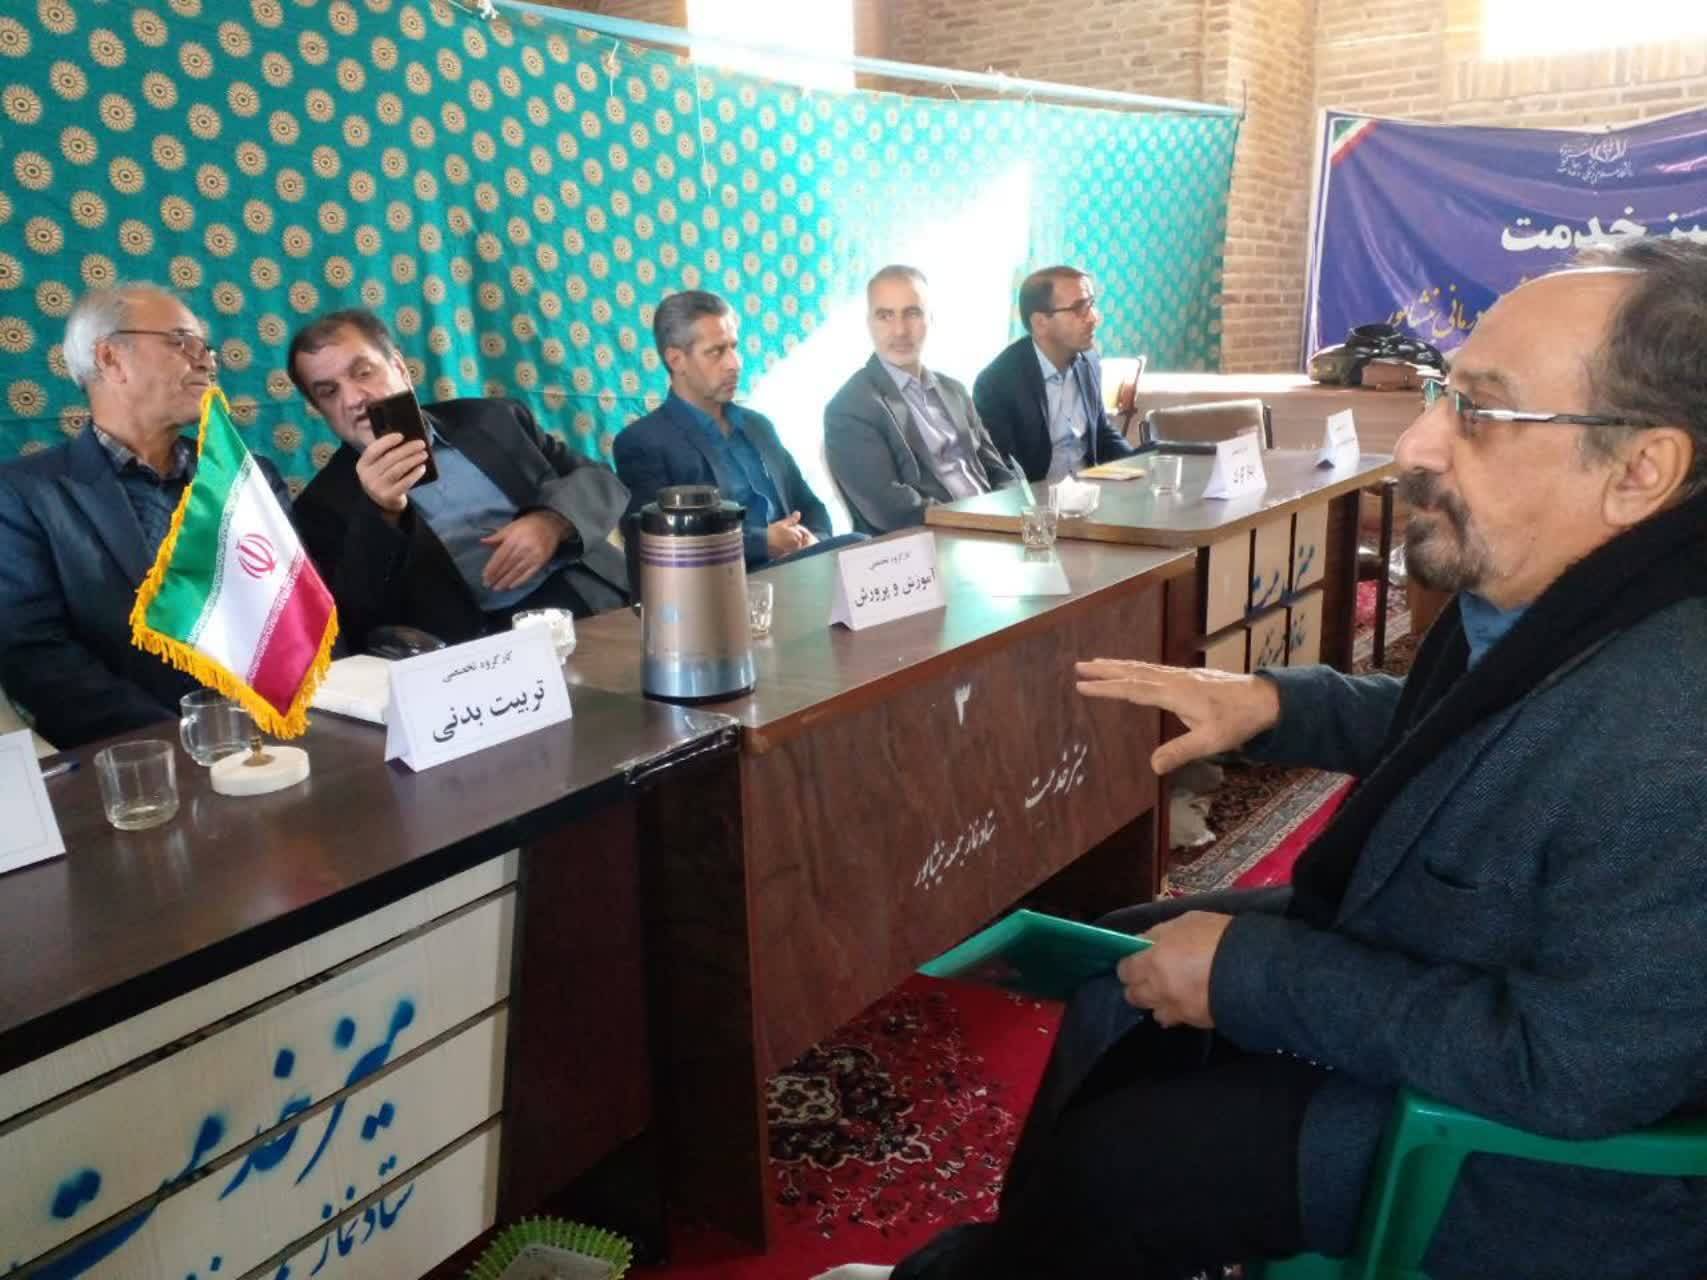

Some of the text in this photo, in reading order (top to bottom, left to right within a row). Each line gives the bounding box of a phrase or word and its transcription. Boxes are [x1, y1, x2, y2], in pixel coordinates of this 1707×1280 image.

[1501, 206, 1647, 252] خدمت
[854, 586, 890, 608] پرورش
[902, 566, 936, 595] آموزش
[432, 679, 546, 743] تربیت بدنی
[8, 998, 417, 1280] میز خدمت
